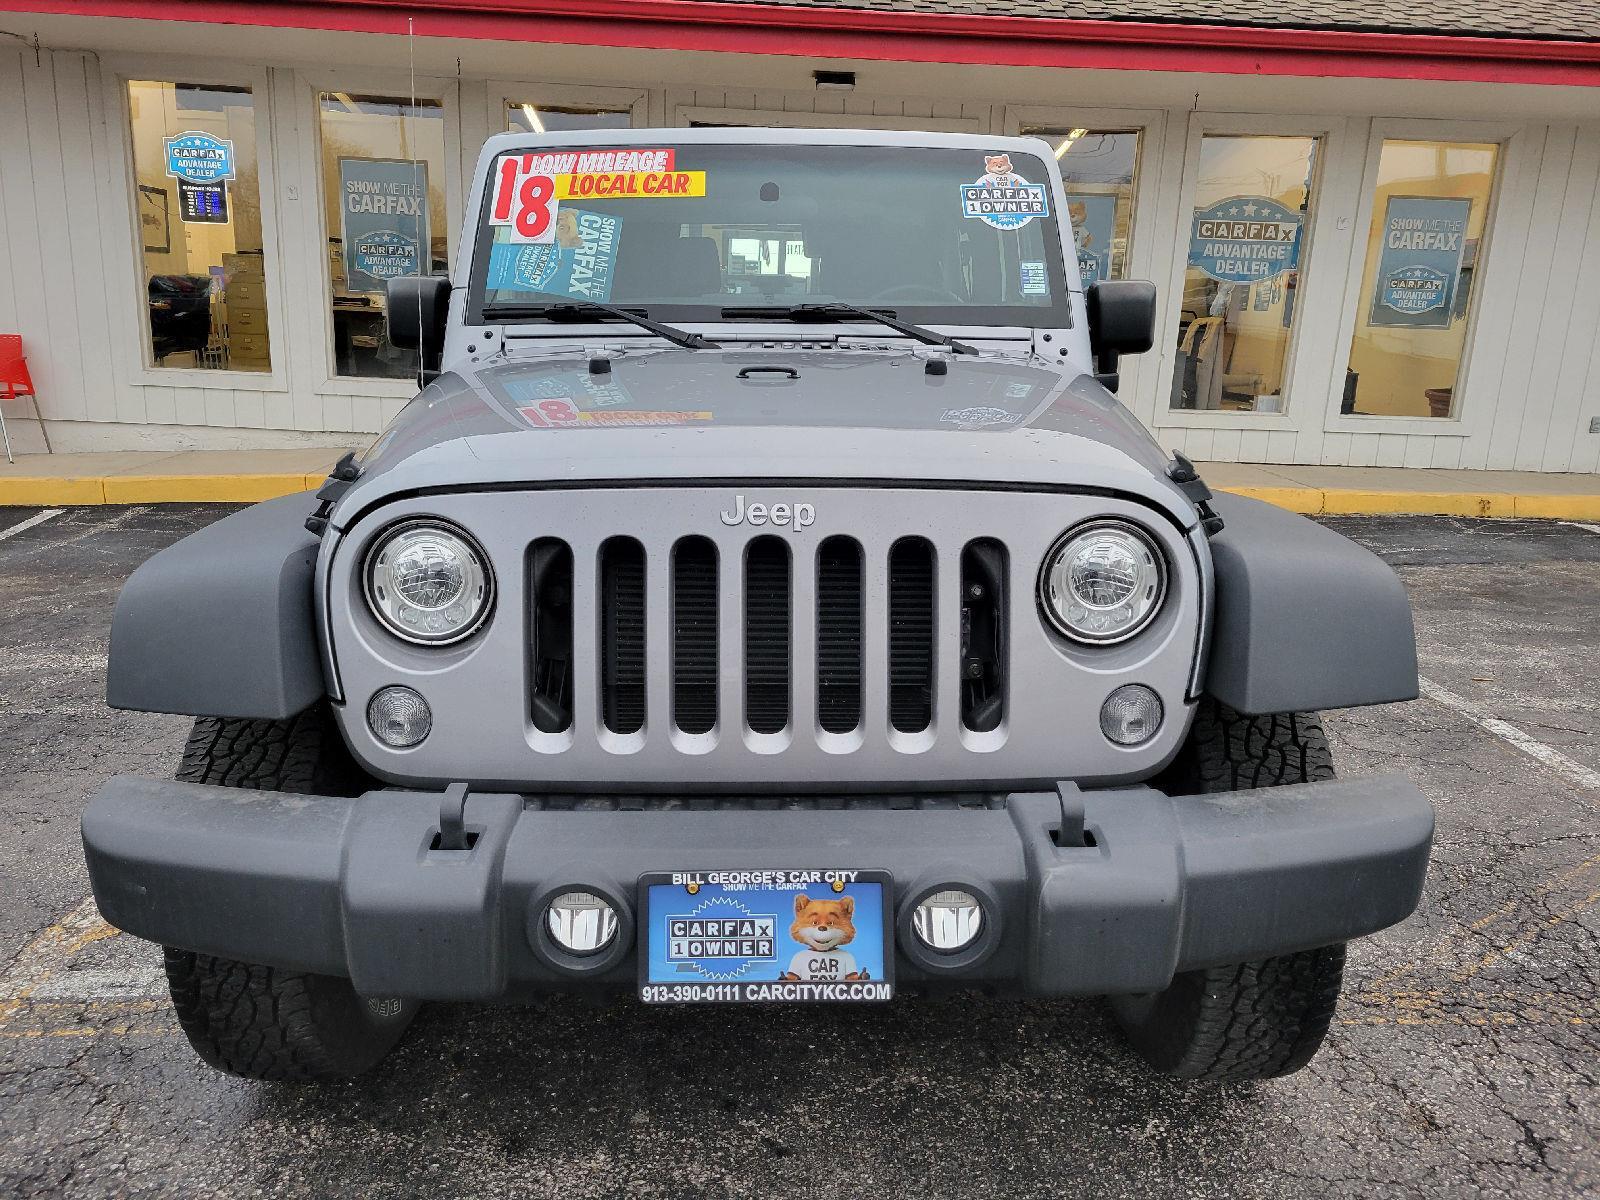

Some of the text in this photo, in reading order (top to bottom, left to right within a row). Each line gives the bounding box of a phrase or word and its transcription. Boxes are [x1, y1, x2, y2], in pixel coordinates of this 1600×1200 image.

[173, 148, 224, 160] CARFAX
[178, 160, 222, 169] ADVANTAGE
[531, 151, 668, 174] LOW MILEAGE
[186, 169, 215, 177] DEALER
[346, 181, 420, 196] SHOW ME THE
[568, 173, 690, 196] LOCAL CAR
[967, 189, 1040, 199] CARFAX
[348, 193, 422, 216] CARFAX
[1201, 223, 1293, 241] CARFAX
[1390, 218, 1462, 232] SHOW ME THE
[1388, 231, 1460, 251] CARFAX
[360, 245, 414, 257] CARFAX
[568, 214, 601, 296] CARFAX
[590, 217, 616, 298] SHOW ME THE
[1203, 243, 1285, 259] ADVANTAGE
[364, 256, 411, 266] ADVANTAGE
[524, 245, 541, 278] DVANTAGE
[1216, 260, 1270, 275] DEALER
[372, 266, 403, 275] DEALER
[1390, 280, 1441, 290] CARFAX
[1391, 290, 1437, 300] ADVANTAGE
[1397, 299, 1428, 309] DEALER
[720, 495, 816, 532] Jeep
[672, 871, 858, 885] BILL GEORGE'S CAR CITY
[722, 883, 746, 891] SHOW
[748, 883, 760, 891] ME
[776, 882, 807, 891] CARFAX
[673, 922, 769, 937] CARFAX
[808, 958, 839, 973] CAR
[642, 984, 891, 1002] 913-390-0111 CARCITYKC.COM
